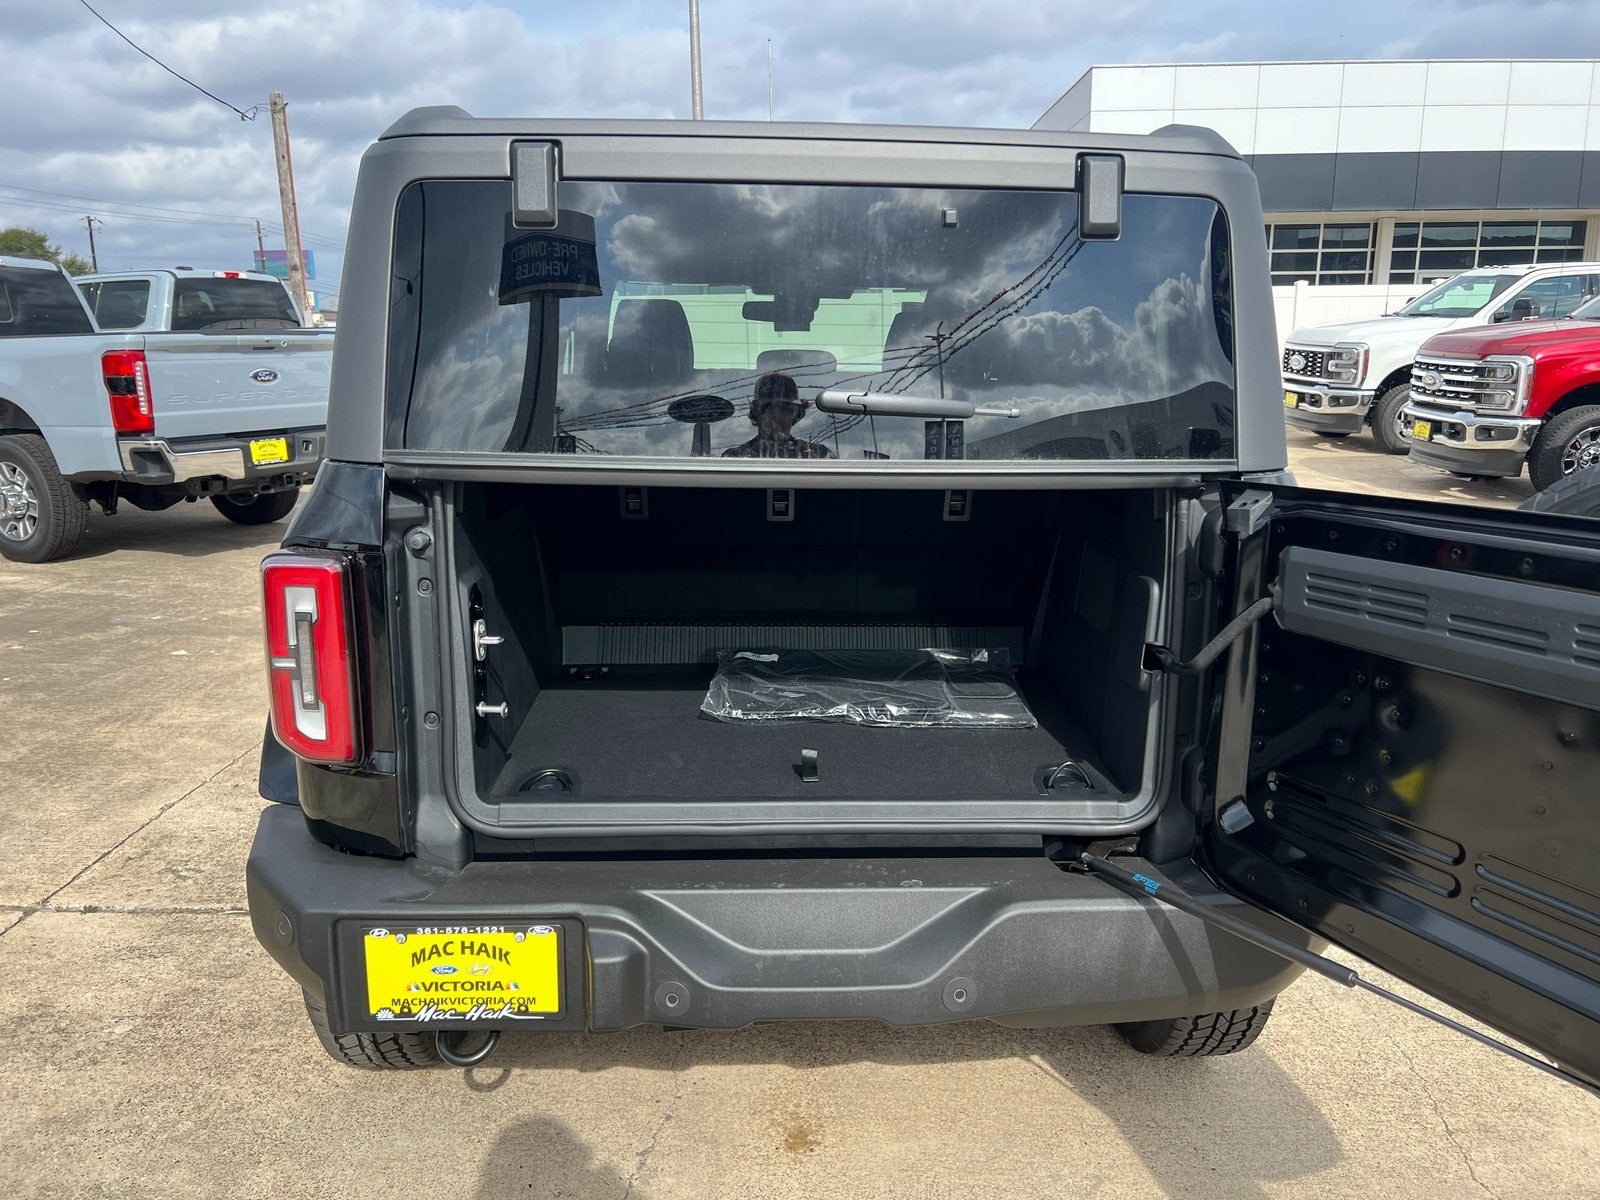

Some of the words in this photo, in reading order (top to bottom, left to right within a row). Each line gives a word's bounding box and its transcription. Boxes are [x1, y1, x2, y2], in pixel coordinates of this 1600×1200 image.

[416, 926, 505, 935] 361-576-1221
[411, 941, 454, 967] MAC
[460, 940, 511, 966] HAIK
[433, 966, 457, 975] Ford
[420, 981, 504, 992] VICTORIA
[391, 996, 536, 1007] MACHAIKVICTORIA.COM
[415, 1003, 463, 1022] Mac
[464, 1003, 524, 1021] Haik
